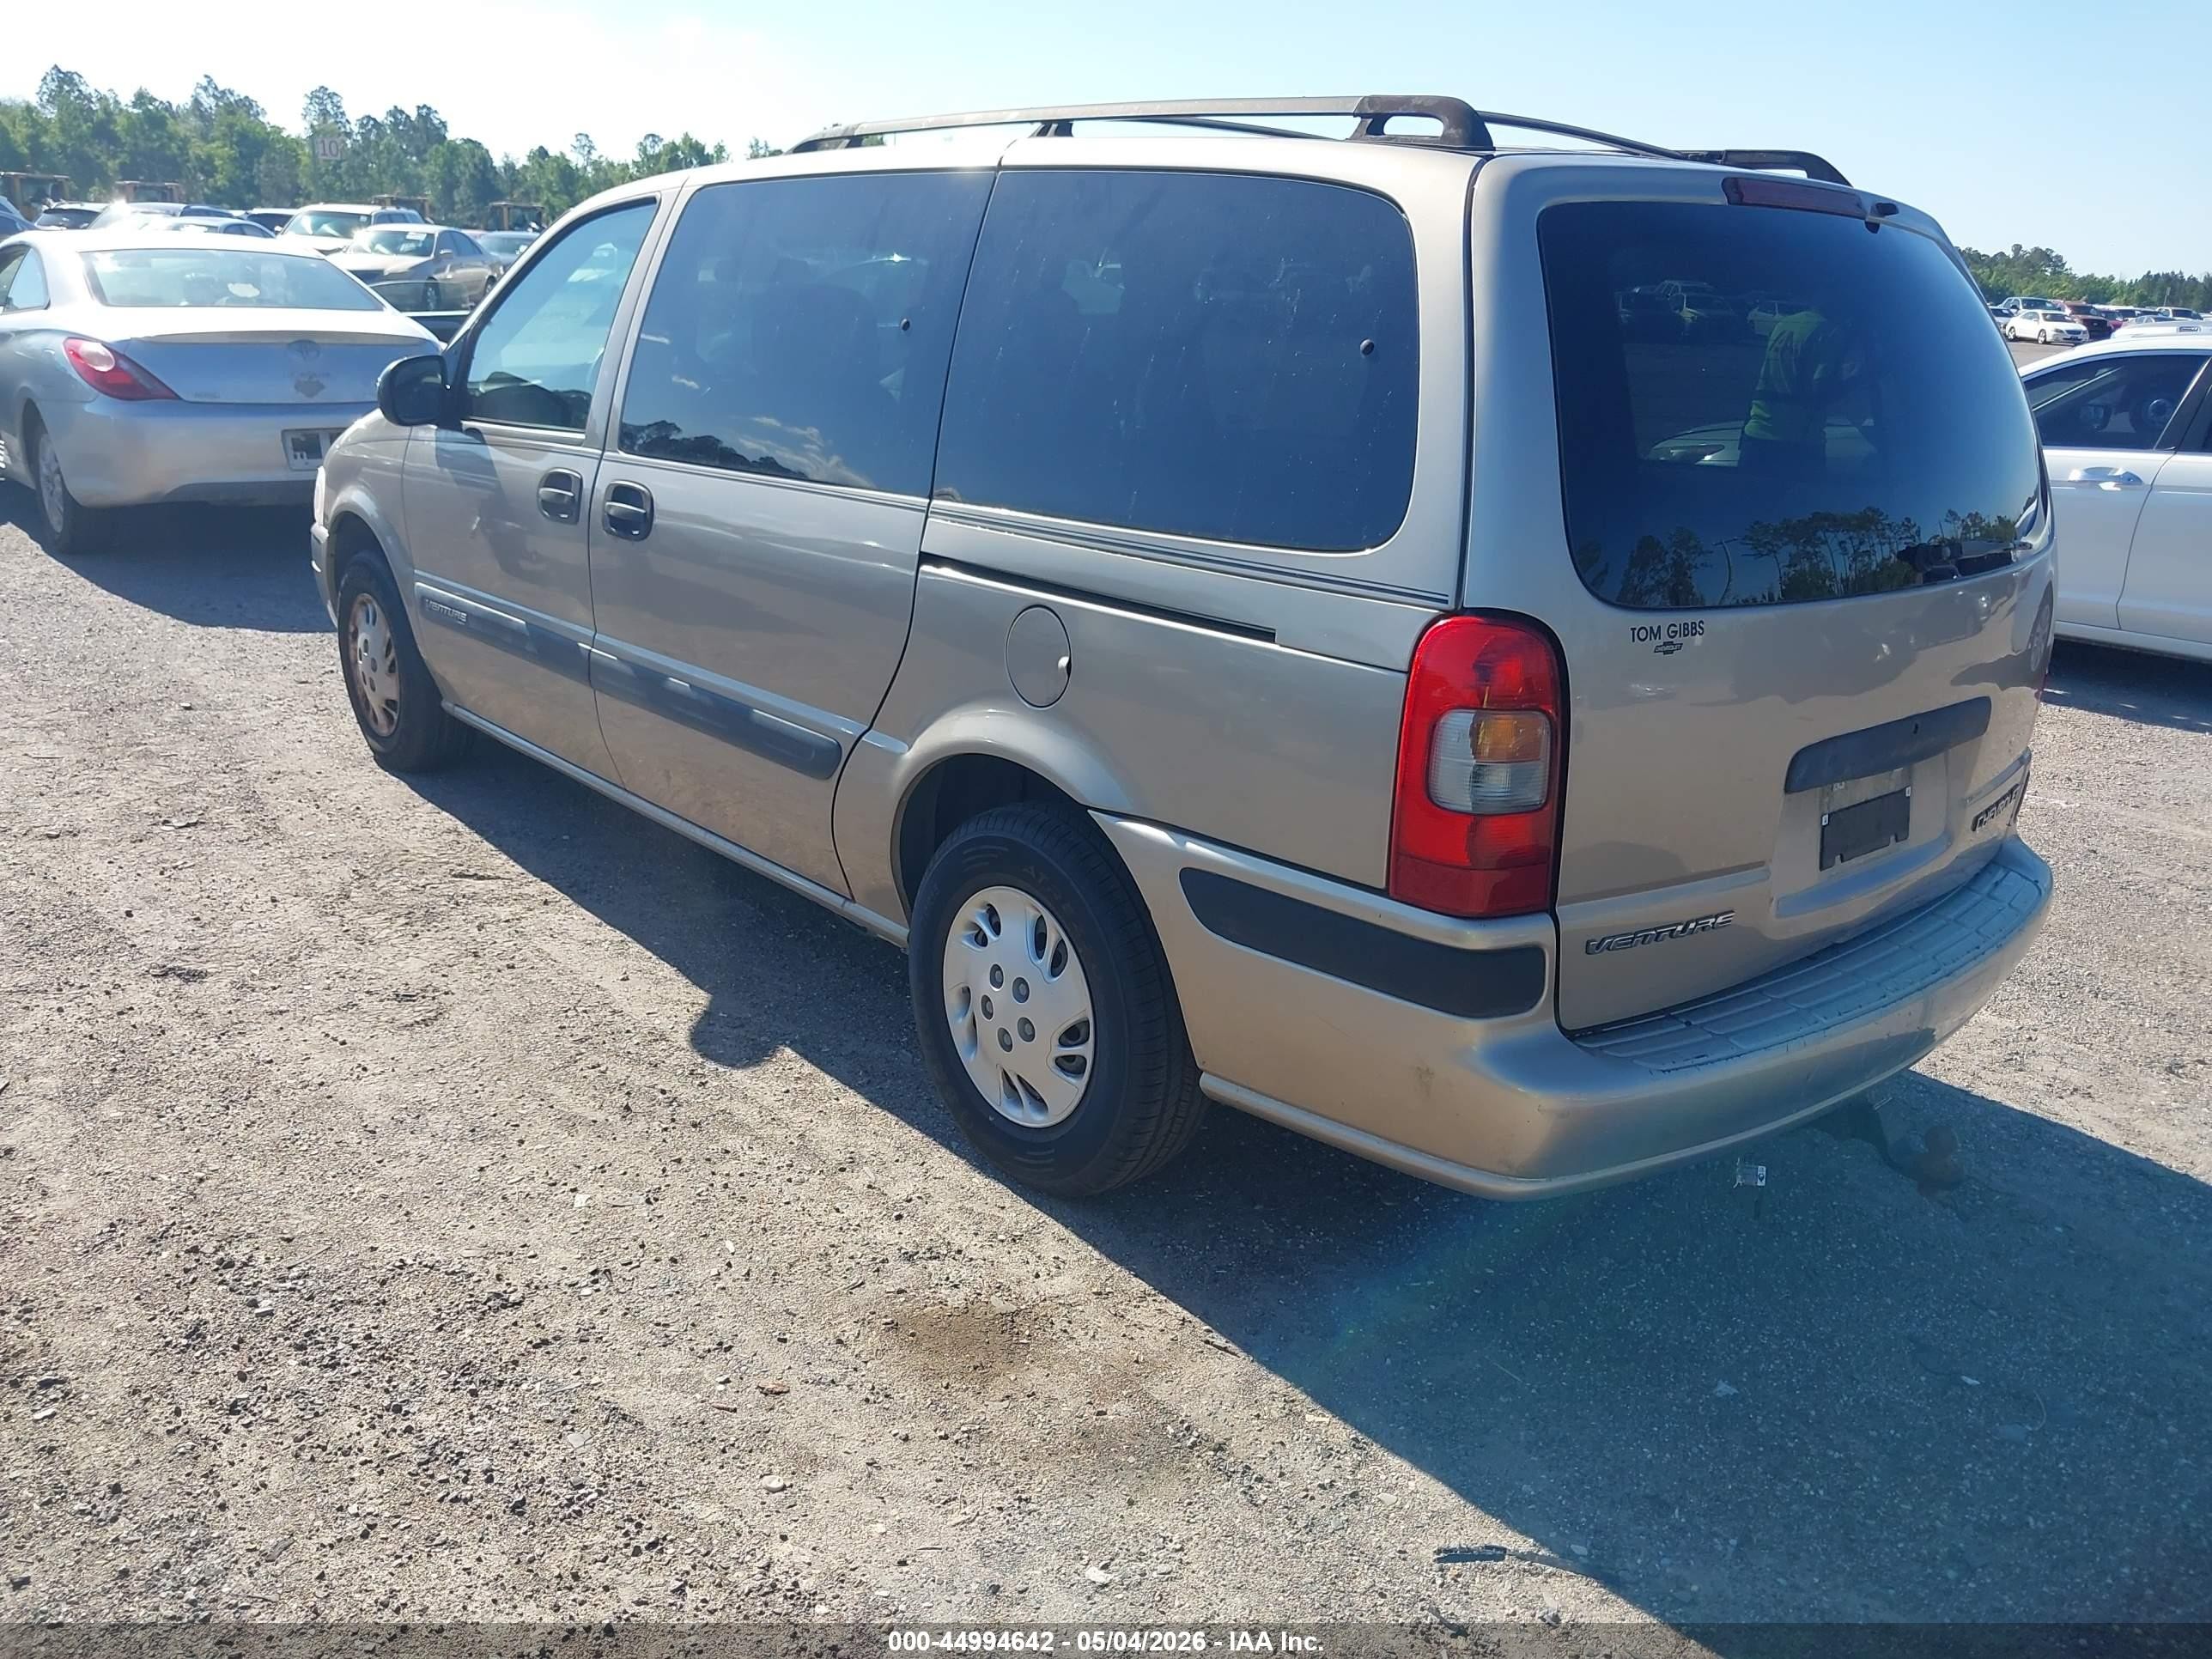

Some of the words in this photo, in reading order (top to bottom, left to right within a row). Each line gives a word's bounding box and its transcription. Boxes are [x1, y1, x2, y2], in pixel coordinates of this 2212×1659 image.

[319, 139, 339, 157] 10
[425, 599, 467, 623] VENTURE
[1630, 625, 1662, 642] TOM
[1667, 620, 1705, 639] GIBBS
[1585, 909, 1736, 955] VENTURE
